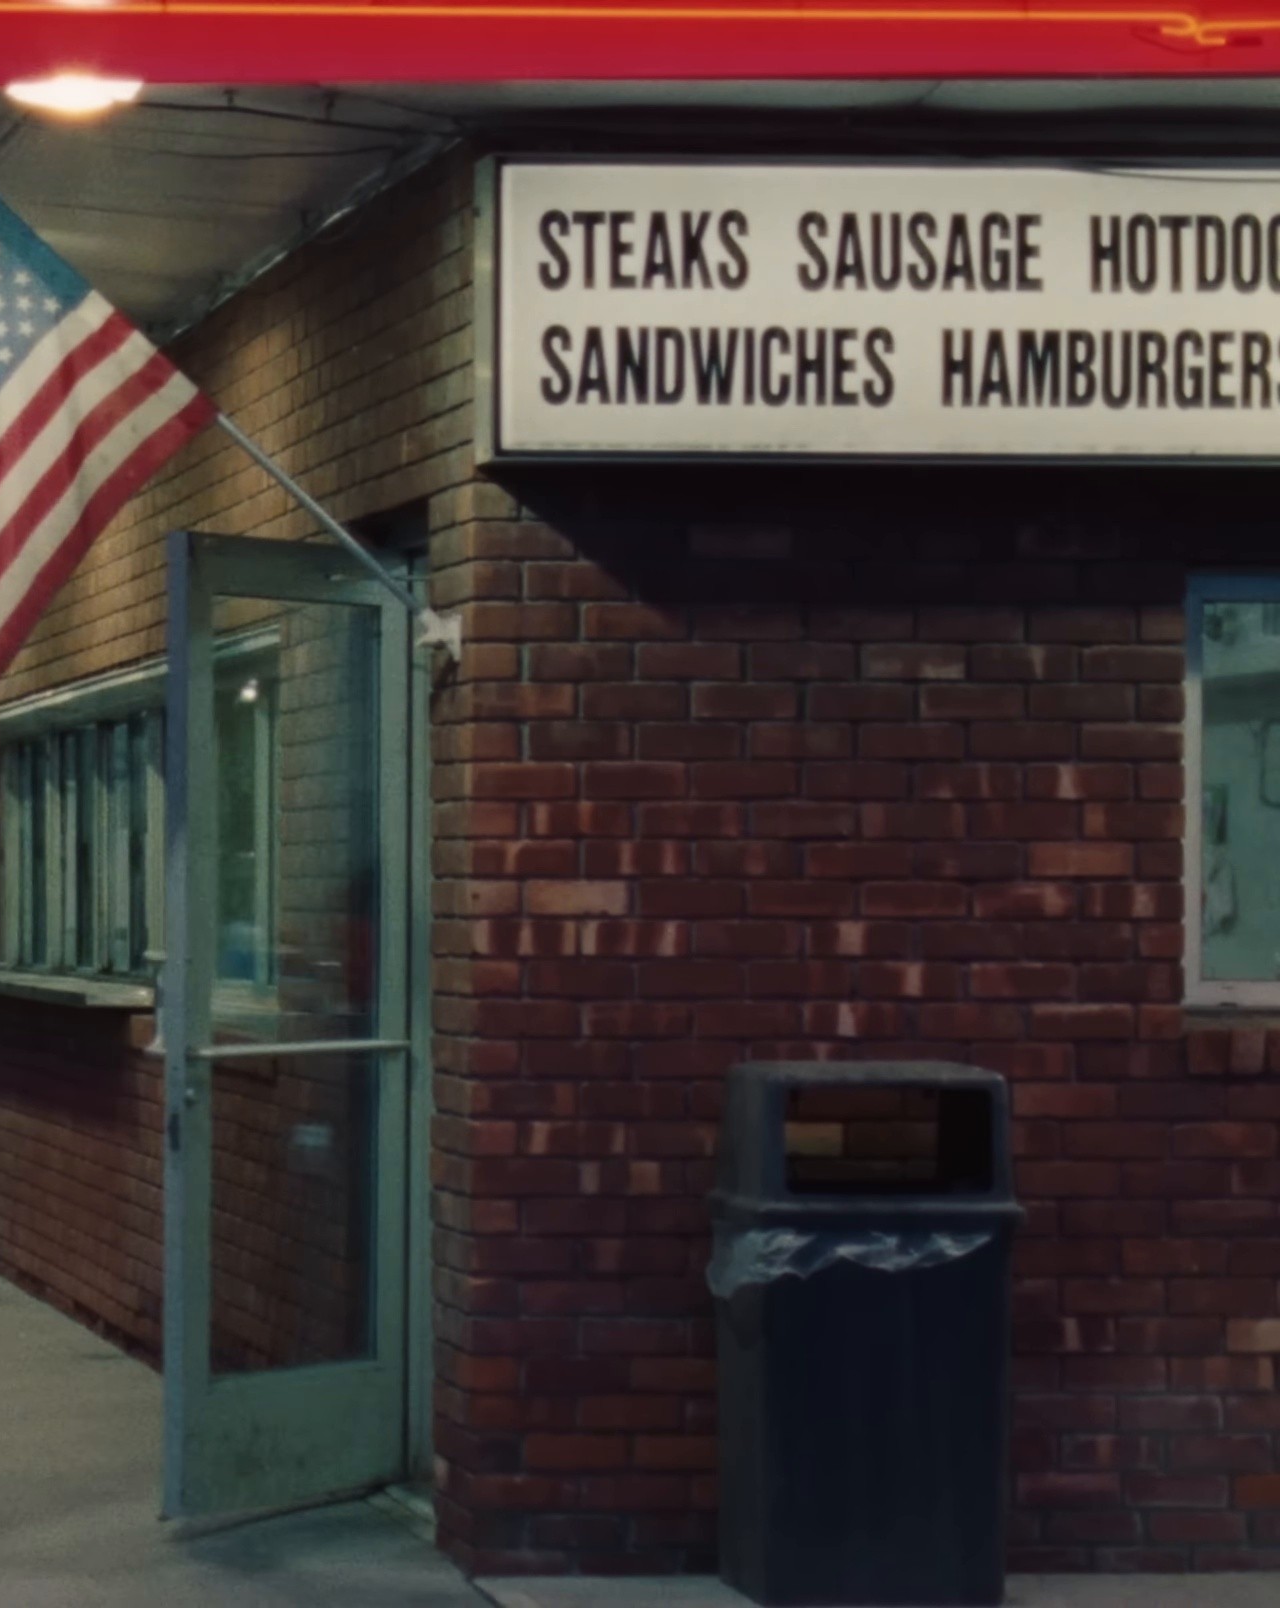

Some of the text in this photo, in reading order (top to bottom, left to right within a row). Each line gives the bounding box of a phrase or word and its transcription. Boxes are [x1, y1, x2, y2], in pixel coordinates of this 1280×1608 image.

[537, 208, 750, 292] STEAKS
[796, 210, 1045, 293] SAUSAGE
[539, 324, 1280, 411] SANDWICHES HAMBURGER
